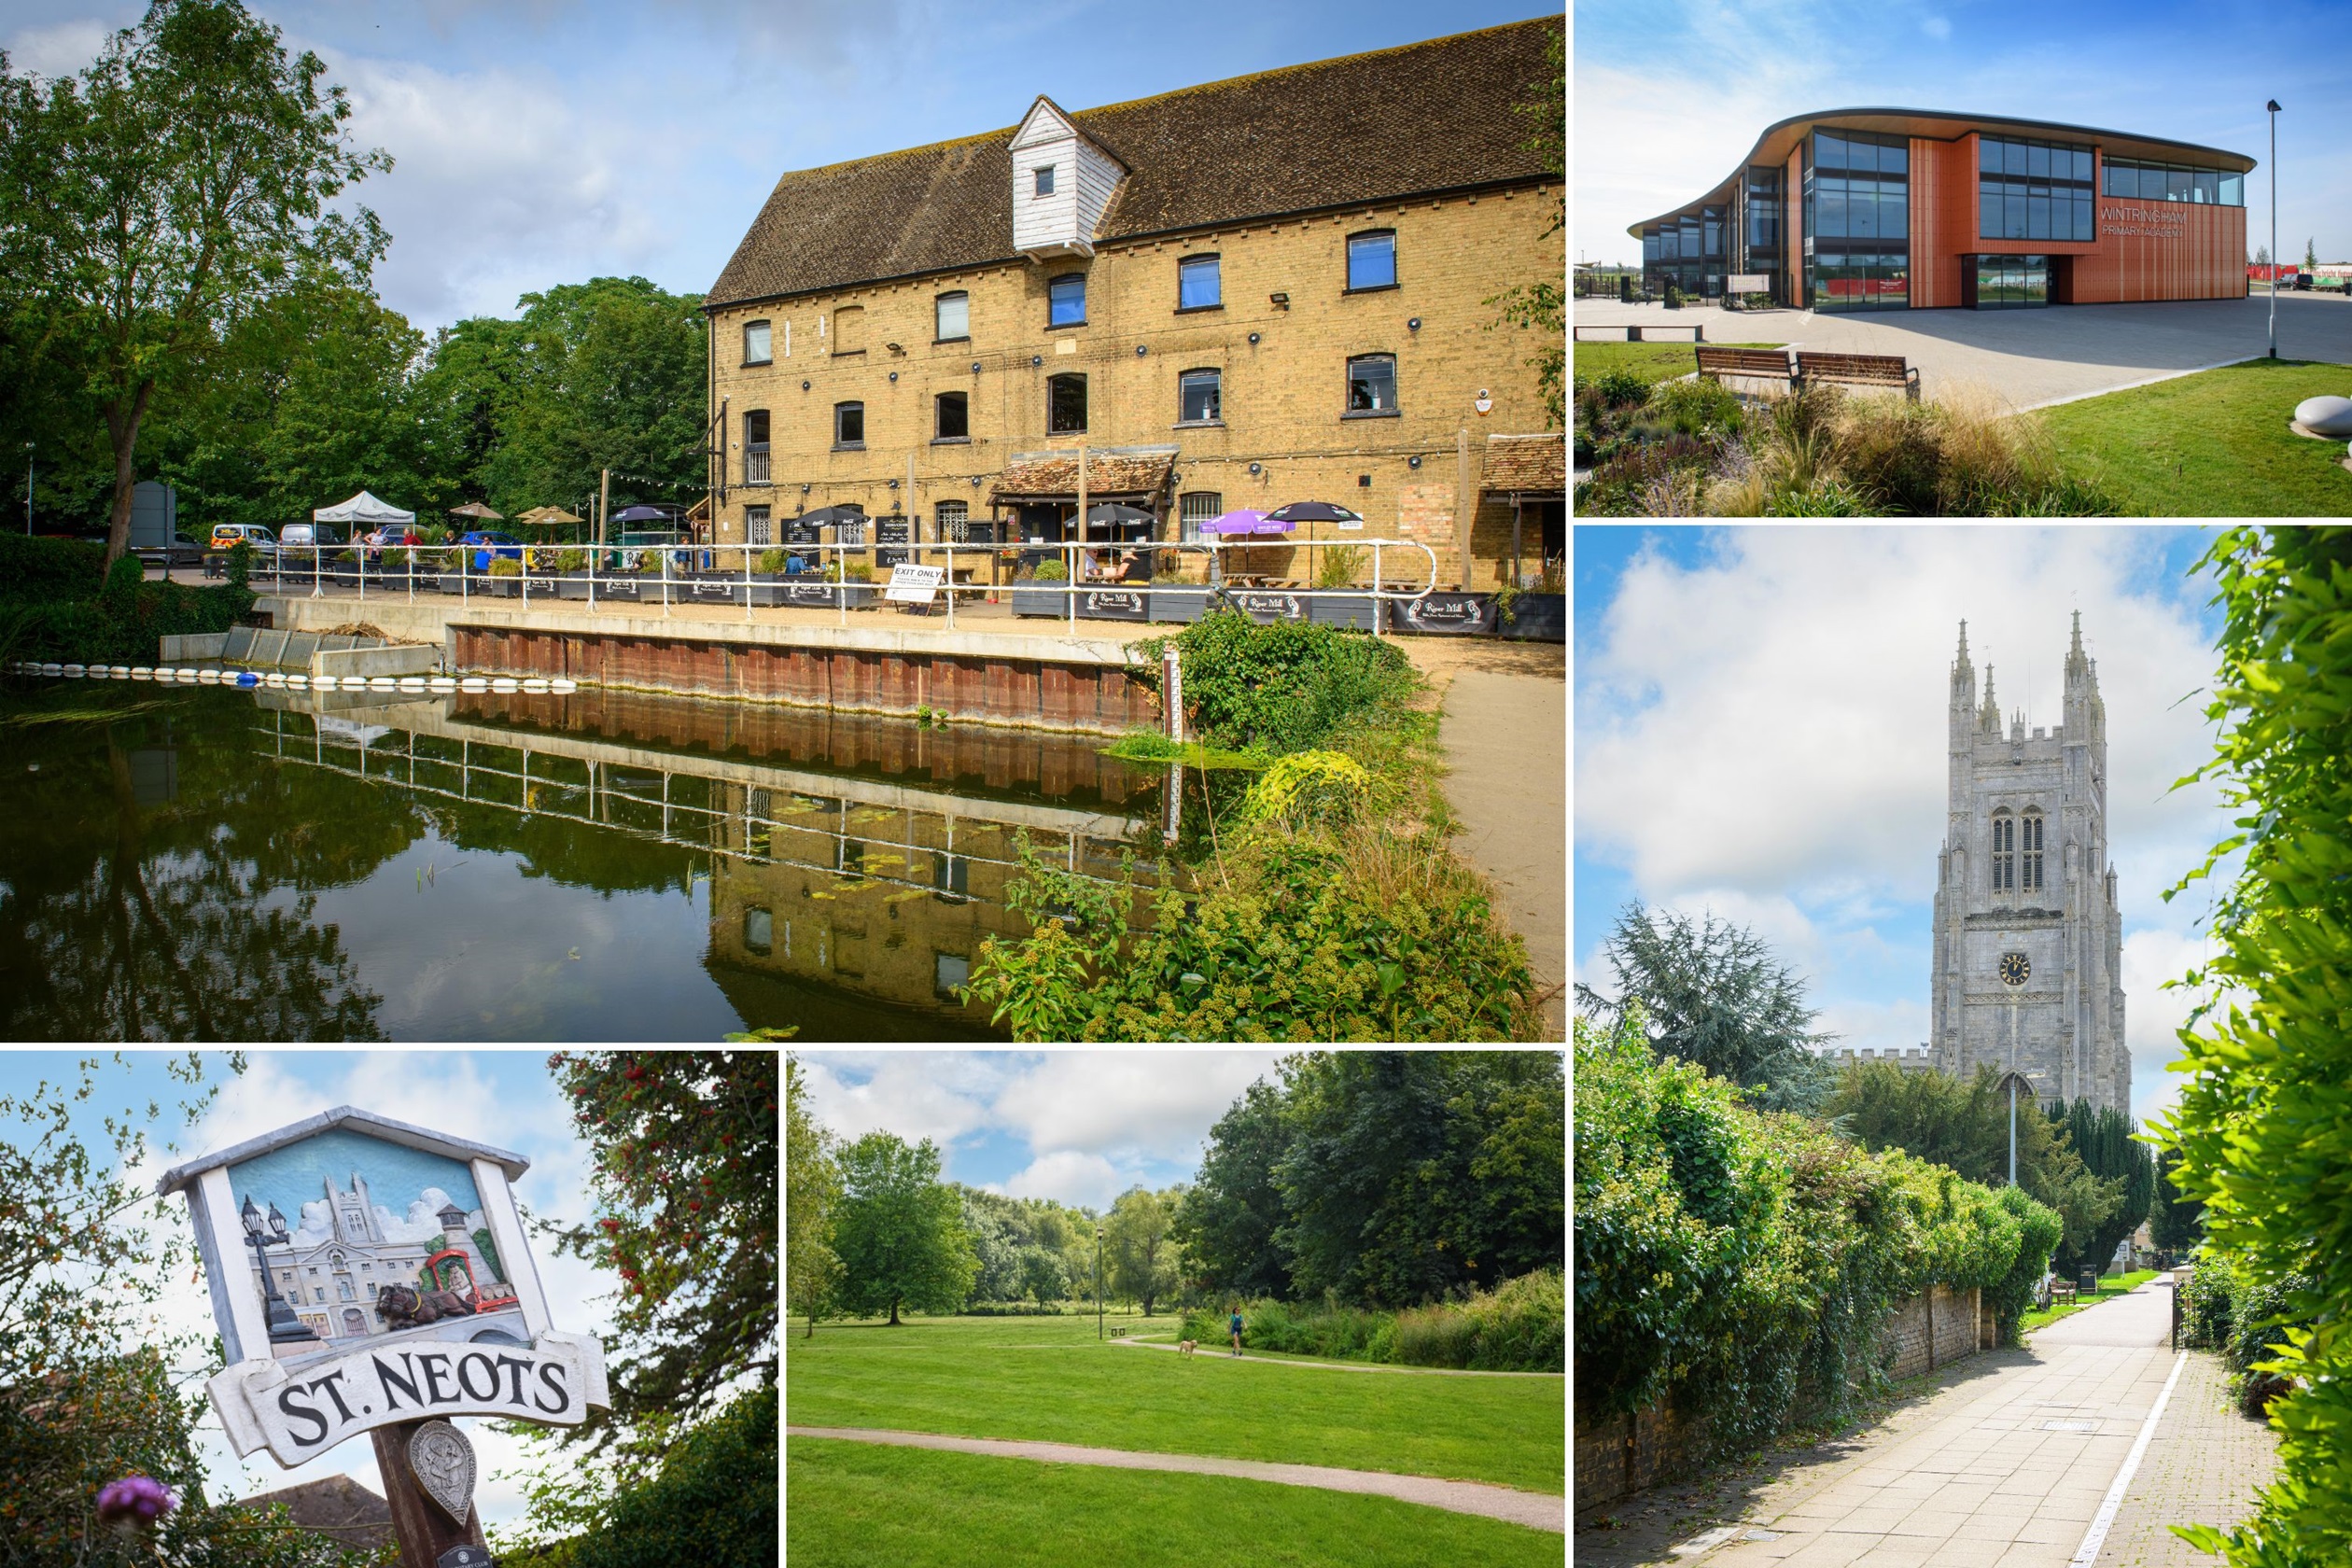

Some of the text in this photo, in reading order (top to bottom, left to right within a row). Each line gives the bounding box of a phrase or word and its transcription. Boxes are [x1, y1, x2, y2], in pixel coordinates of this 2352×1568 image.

[2101, 207, 2187, 223] WINTRINGHAM
[2102, 225, 2182, 237] PRIMARY ACADEMY
[895, 567, 916, 576] EXIT
[1115, 594, 1127, 602] Mill
[1250, 597, 1283, 608] River Mill
[1425, 602, 1463, 613] River Mill
[279, 1352, 569, 1446] ST. NEOTS
